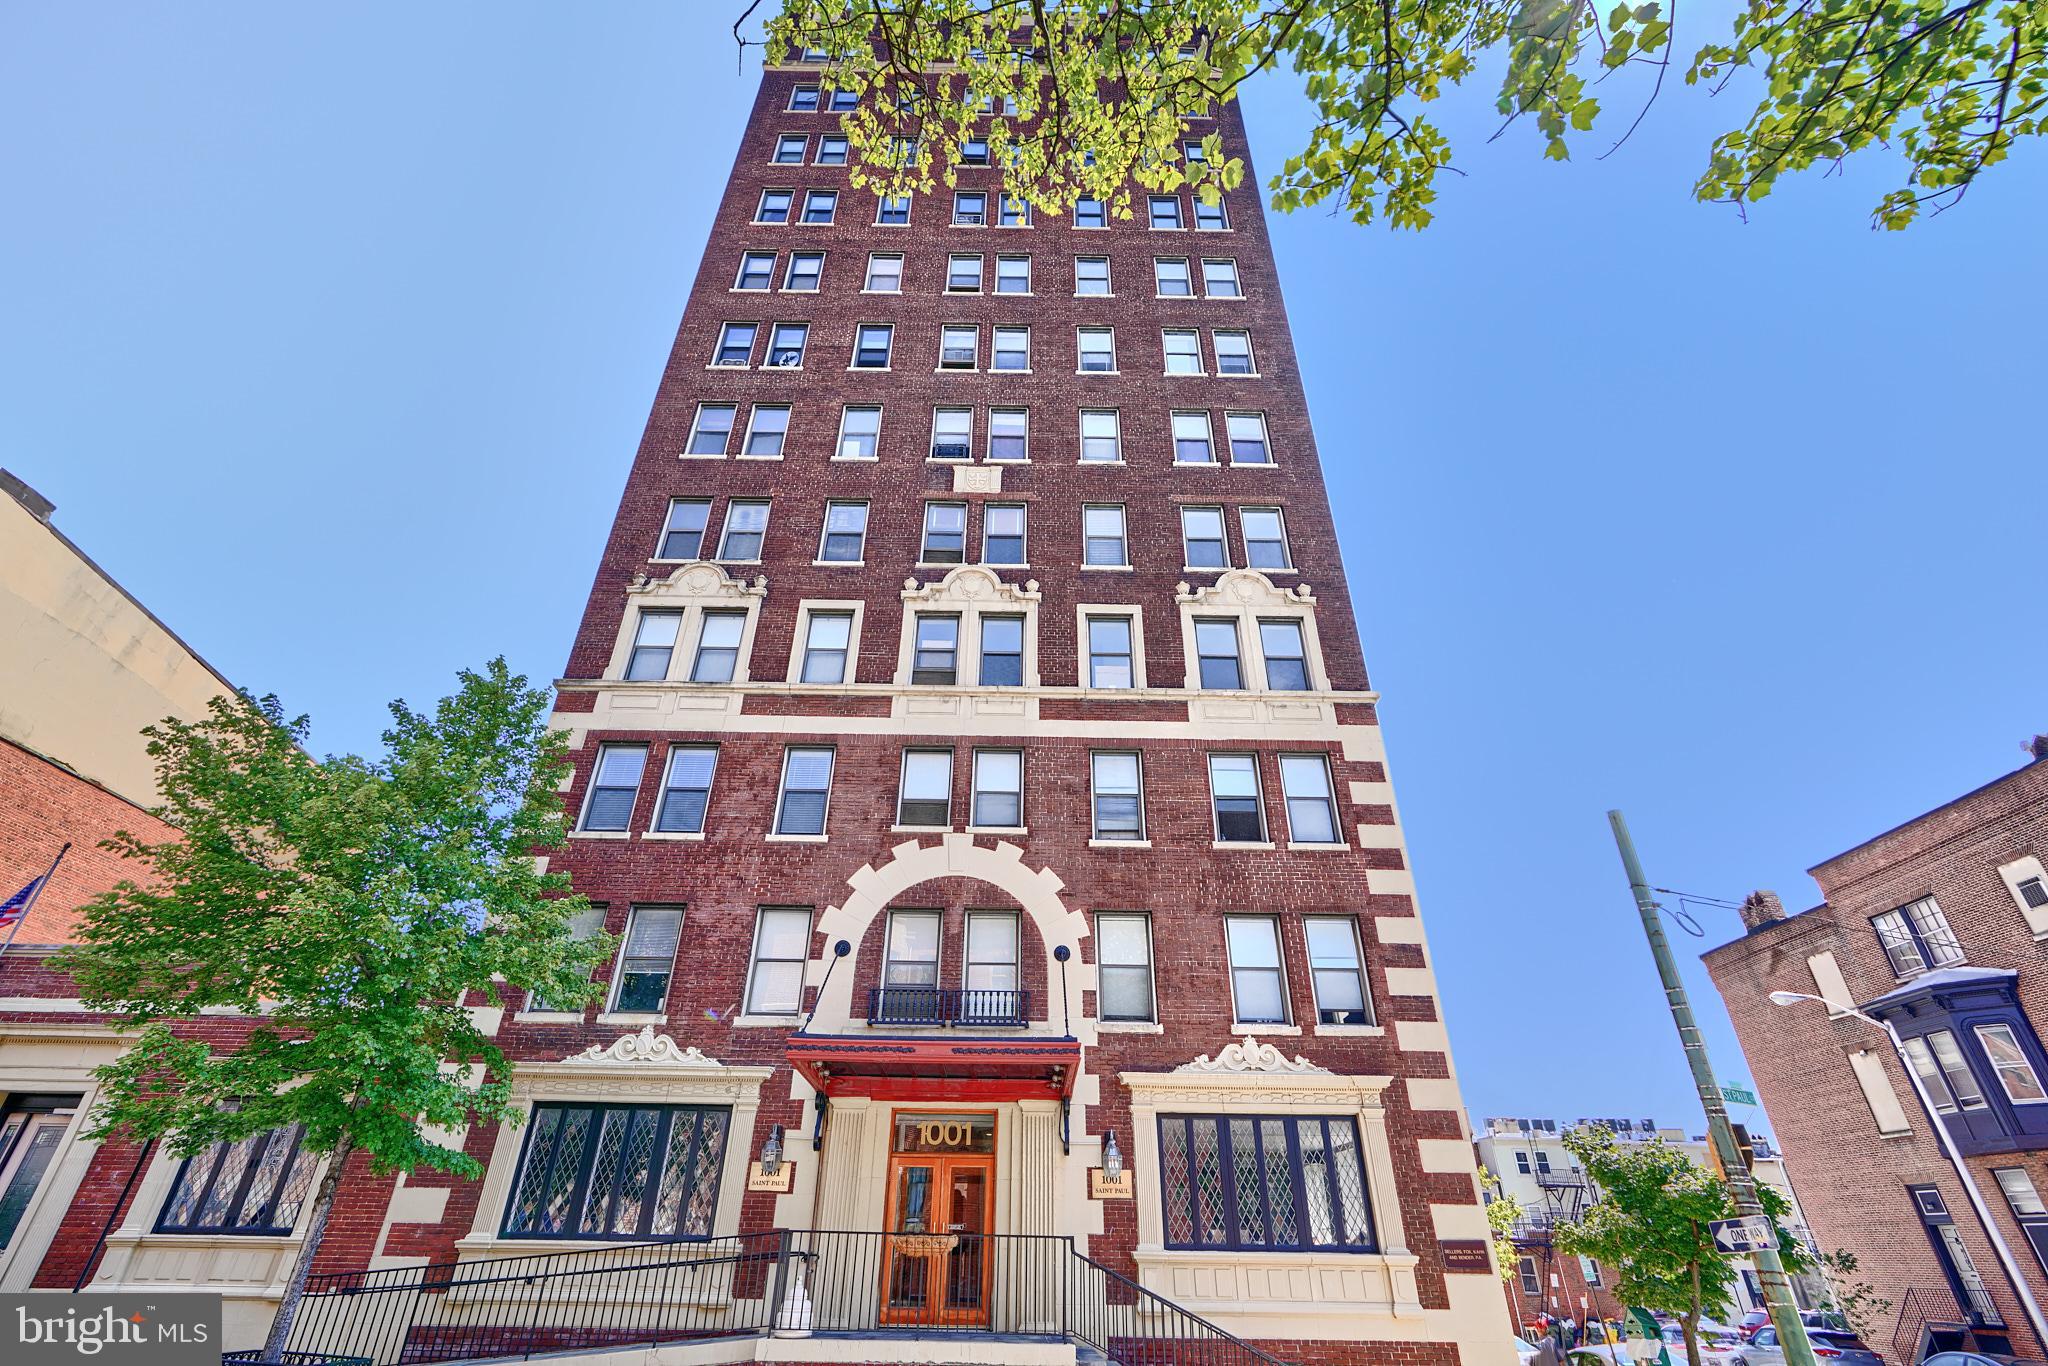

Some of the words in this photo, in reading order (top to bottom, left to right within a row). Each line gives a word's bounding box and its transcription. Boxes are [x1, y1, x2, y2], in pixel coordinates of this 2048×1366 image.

[917, 1120, 972, 1146] 1001
[1102, 1175, 1122, 1184] 1001
[1730, 1229, 1749, 1242] ONE
[1748, 1227, 1764, 1241] WAY
